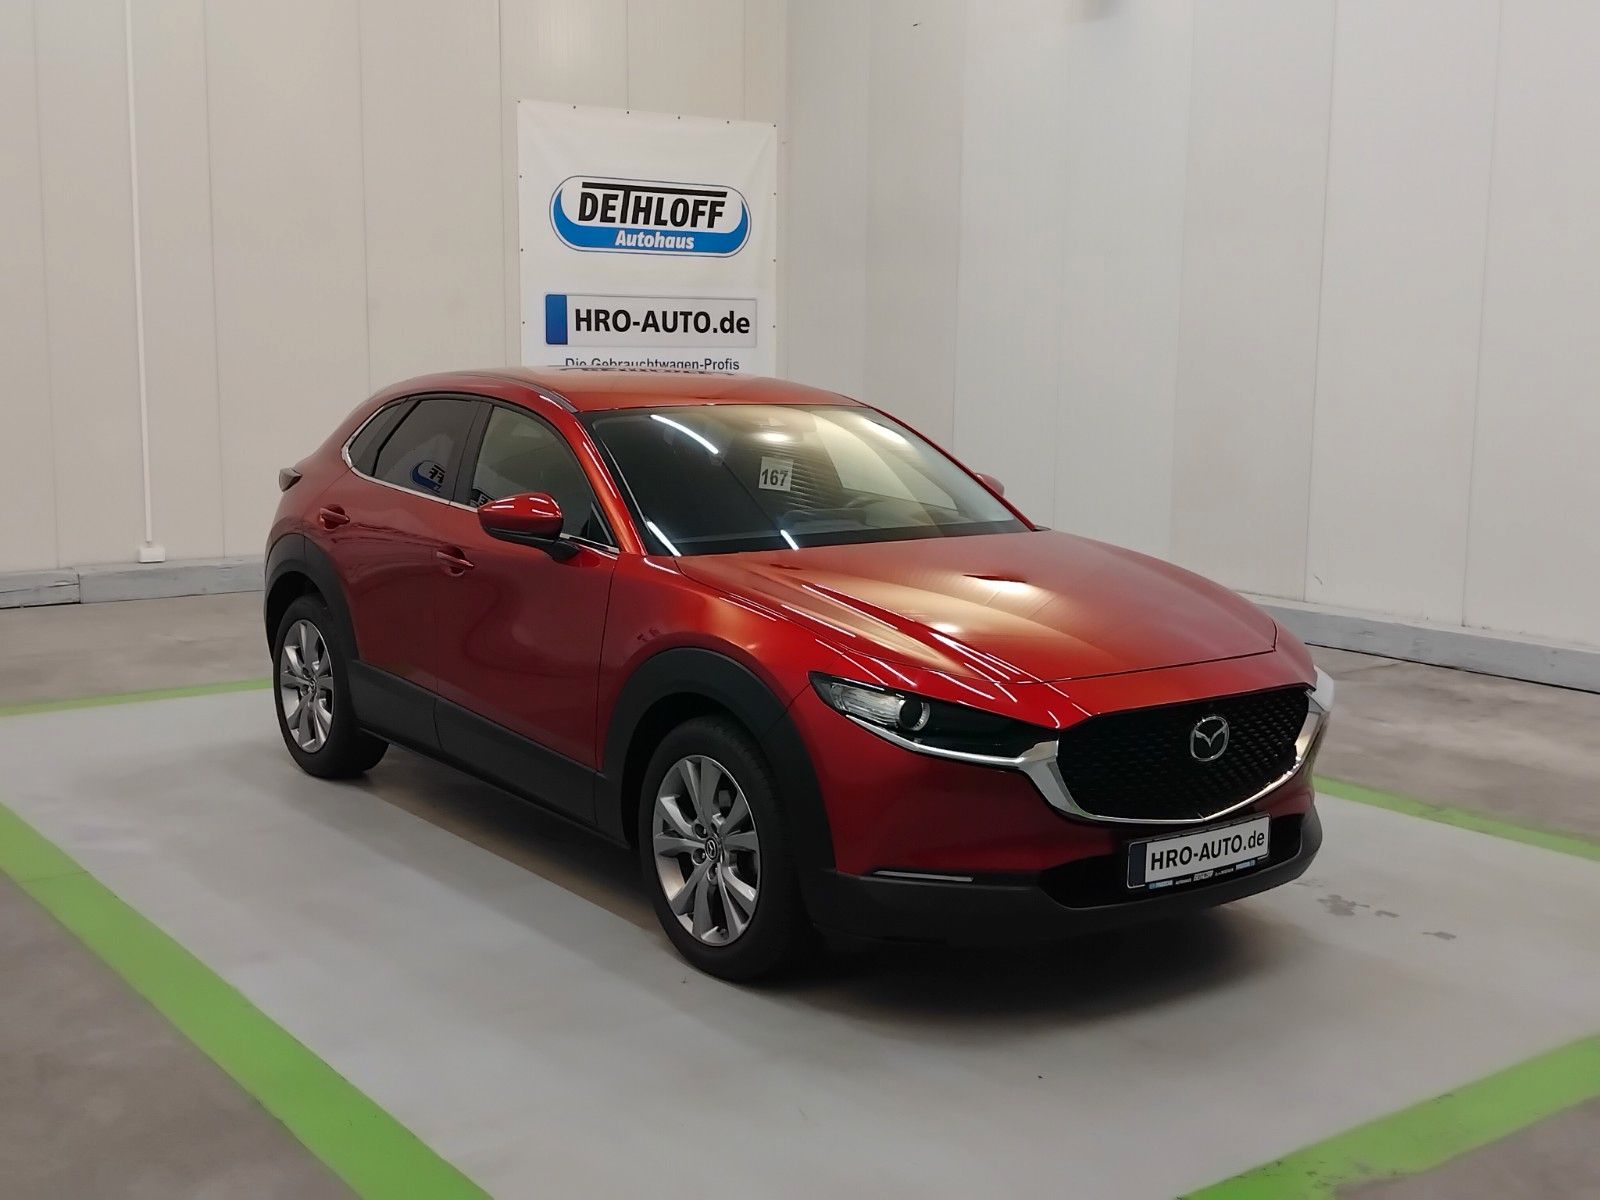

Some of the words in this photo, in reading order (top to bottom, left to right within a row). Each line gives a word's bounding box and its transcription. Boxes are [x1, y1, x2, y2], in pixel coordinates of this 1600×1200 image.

[578, 182, 728, 229] DETHLOFF
[614, 229, 695, 250] Autohaus
[575, 308, 751, 334] HRO-AUTO.de
[761, 469, 789, 487] 167
[1151, 830, 1265, 871] HRO-AUTO.de
